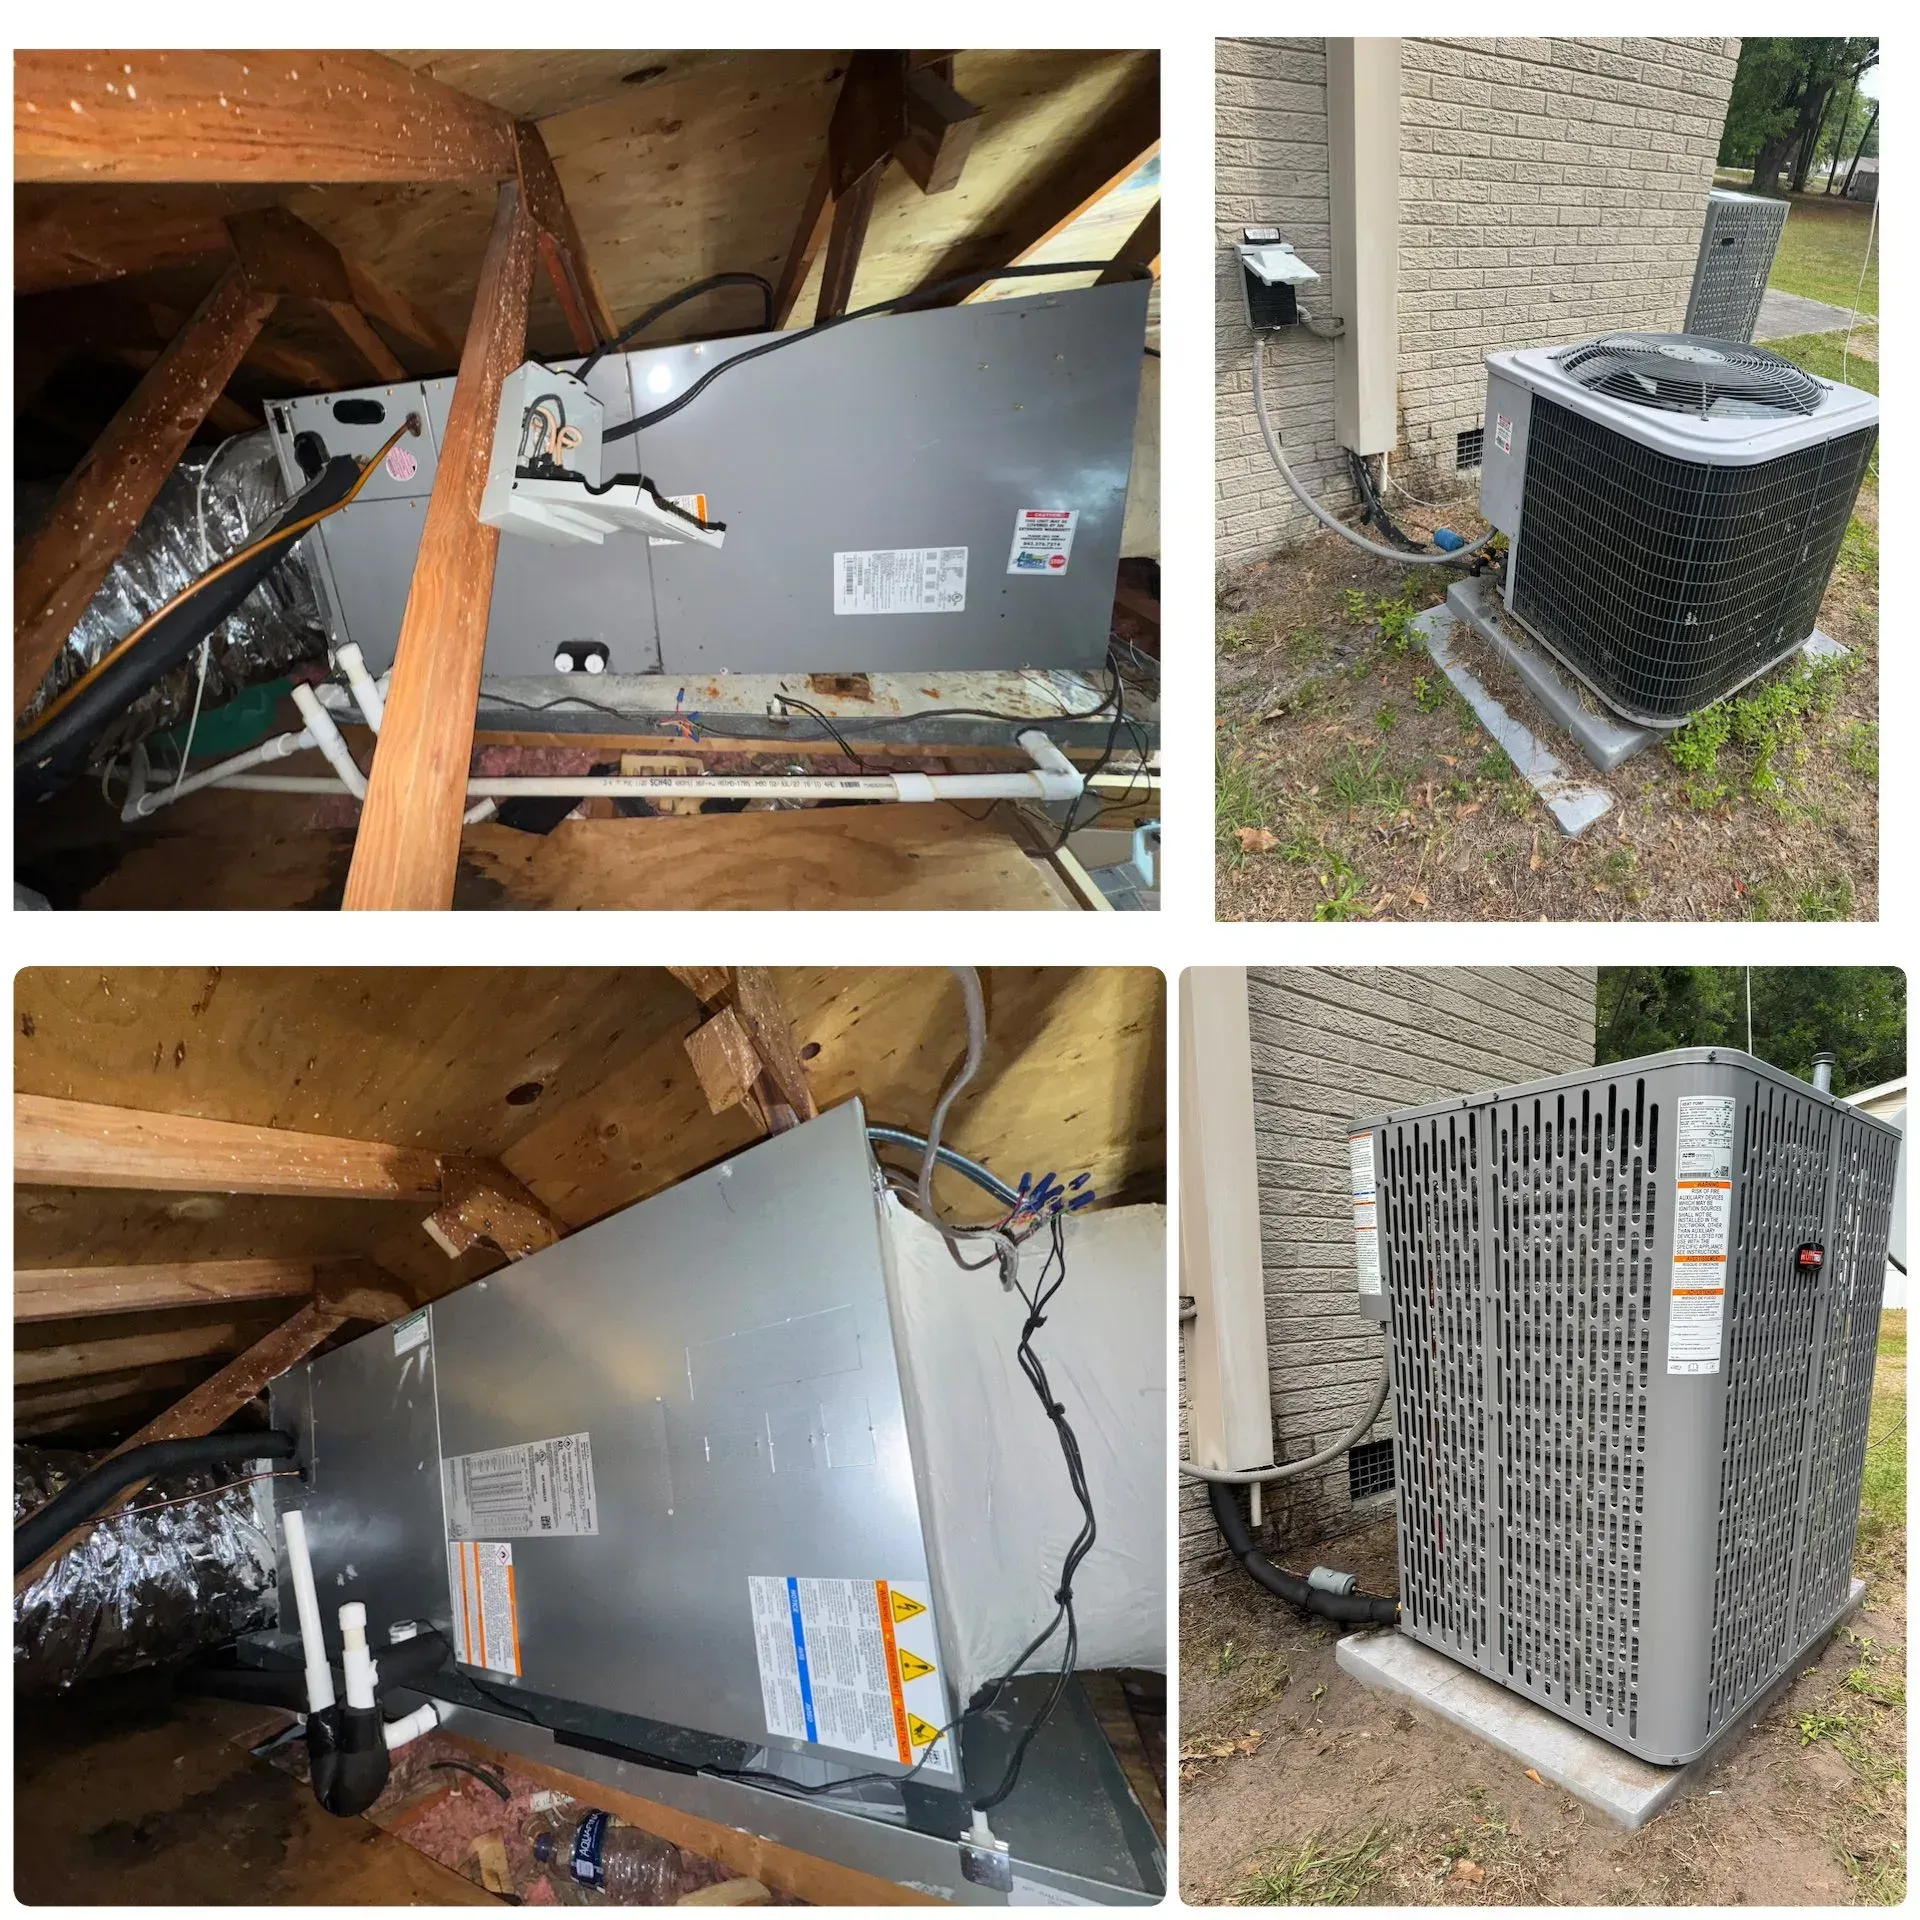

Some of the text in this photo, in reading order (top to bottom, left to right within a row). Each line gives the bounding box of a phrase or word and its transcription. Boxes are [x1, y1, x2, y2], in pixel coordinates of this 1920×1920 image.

[650, 778, 672, 787] SCH40
[790, 1588, 799, 1614] NOTICE
[880, 1590, 890, 1623] WARNING
